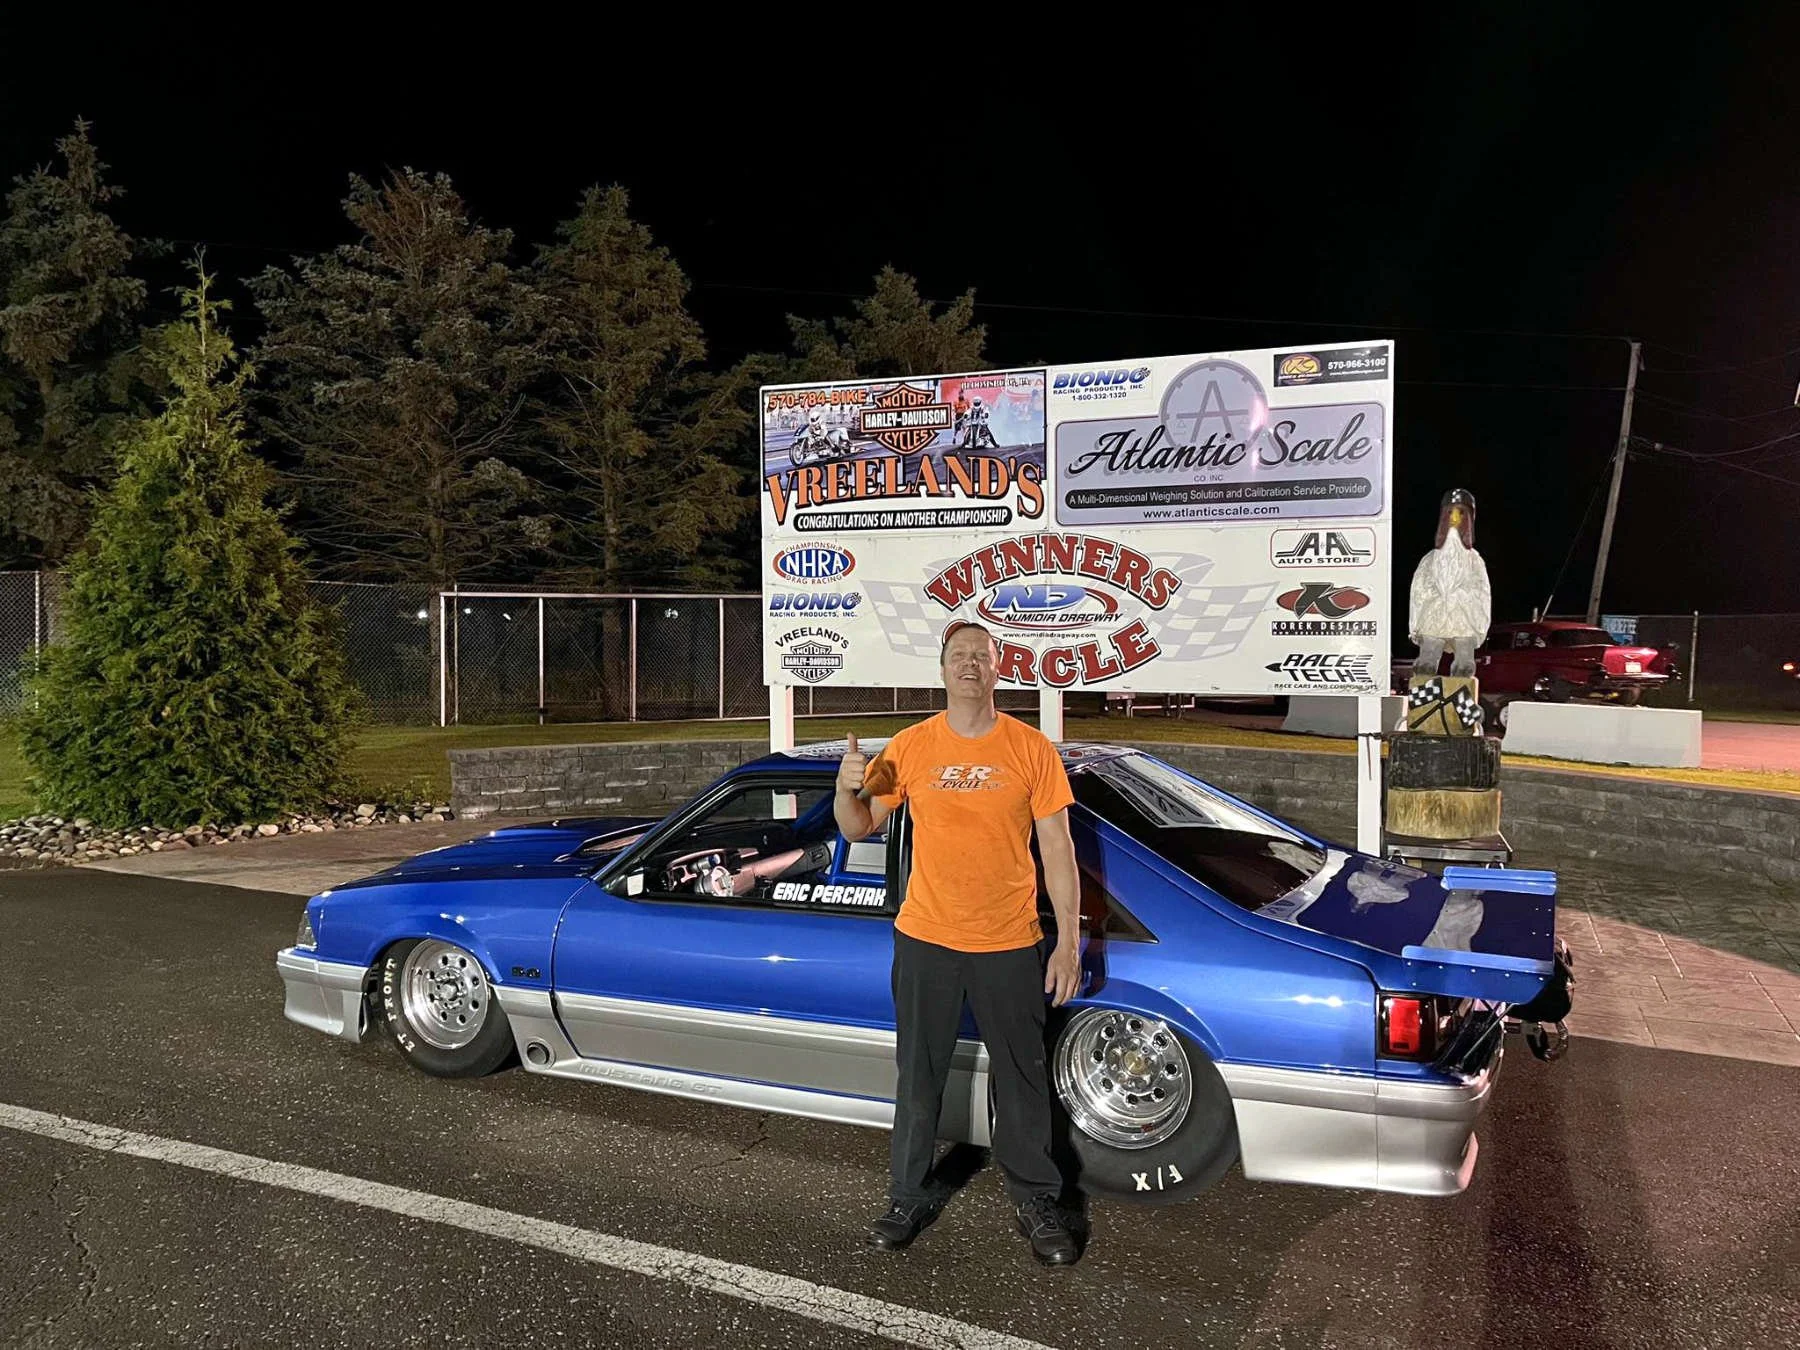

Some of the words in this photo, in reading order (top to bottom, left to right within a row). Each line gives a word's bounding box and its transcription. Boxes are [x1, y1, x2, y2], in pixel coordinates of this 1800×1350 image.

[1053, 367, 1151, 389] BIONDO
[767, 389, 868, 410] 570-784-BIKE
[881, 394, 926, 408] MOTOR
[1072, 392, 1127, 401] 1-800-332-1320
[864, 412, 947, 429] HARLEY-DAVIDSON
[884, 430, 929, 448] CYCLES
[1067, 425, 1247, 474] Atlantic
[1258, 412, 1373, 467] Scale
[765, 454, 1046, 527] VREELAND'S
[1070, 496, 1077, 505] A
[1077, 492, 1148, 505] Multi-Dimensional
[1149, 491, 1188, 503] Weighing
[1190, 489, 1224, 500] Solution
[1226, 488, 1242, 498] and
[1245, 487, 1291, 498] Calibration
[1293, 485, 1327, 495] Service
[1329, 483, 1367, 494] Provider
[797, 512, 879, 529] CONGRATULATIONS
[880, 512, 892, 527] ON
[894, 511, 937, 527] ANOTHER
[938, 508, 1008, 525] CHAMPIONSHIP
[1143, 505, 1280, 519] www.atlanticscale.com
[785, 541, 843, 553] CHAMPIONSHIP
[785, 551, 845, 577] NHRA
[1278, 557, 1312, 565] AUTO
[785, 574, 808, 585] DRAG
[811, 575, 843, 585] RACING
[924, 532, 1182, 610] WINNERS
[769, 592, 862, 611] BIONDO
[1004, 613, 1055, 622] NUMIDIA
[1058, 613, 1123, 622] DRAGWAY
[1272, 622, 1312, 630] KOREK
[1320, 622, 1377, 630] DESIGNS
[775, 627, 849, 650] VREELAND'S
[1003, 632, 1096, 640] www.numidiadragway.com
[797, 647, 826, 655] MOTOR
[993, 618, 1161, 688] RCLE
[785, 657, 839, 666] HARLEY-DAVIDSON
[1283, 654, 1356, 667] RACE
[797, 668, 828, 680] CYCLES
[1283, 669, 1356, 682] TECH
[772, 882, 811, 901] ERIC
[811, 884, 886, 906] PERCHAK
[383, 958, 397, 1022] FRONT
